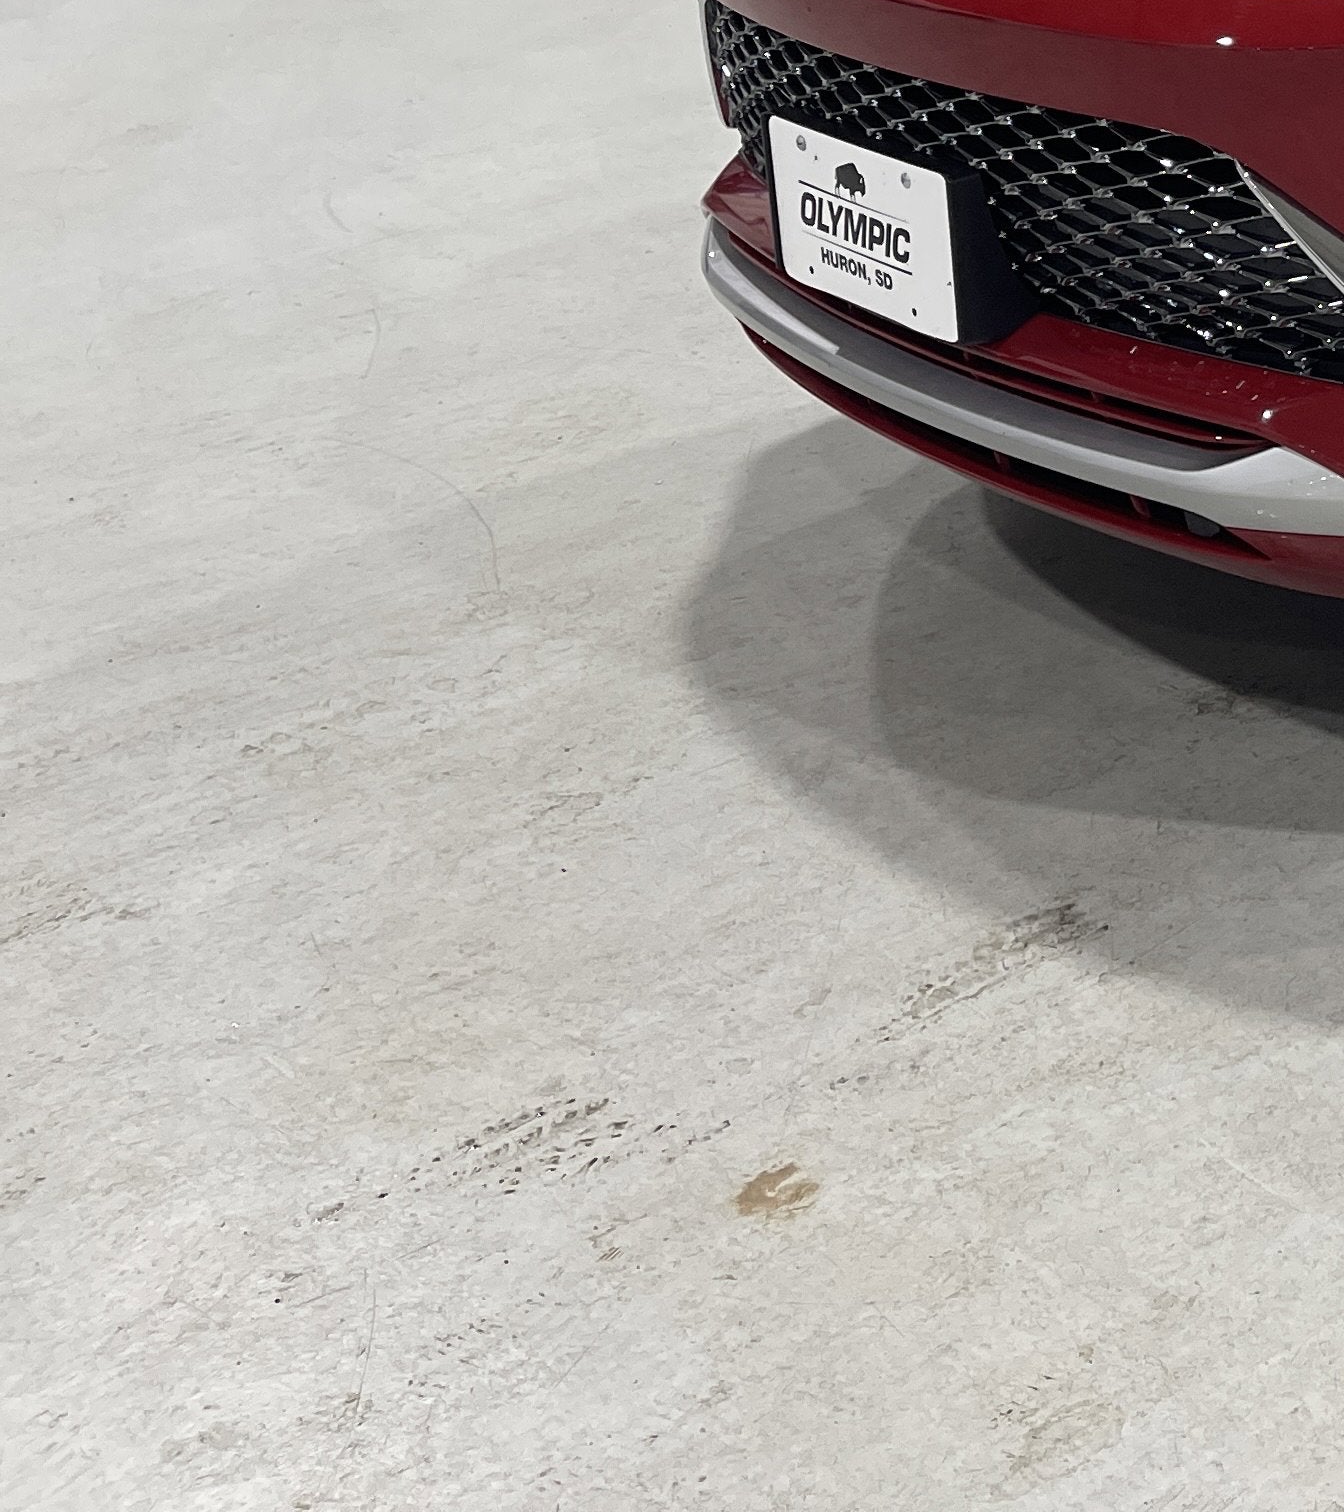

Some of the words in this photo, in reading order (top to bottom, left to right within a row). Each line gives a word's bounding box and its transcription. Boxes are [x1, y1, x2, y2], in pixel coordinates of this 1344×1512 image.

[800, 191, 911, 264] OLYMPIC
[820, 246, 871, 285] HURON,
[875, 270, 893, 290] SD
